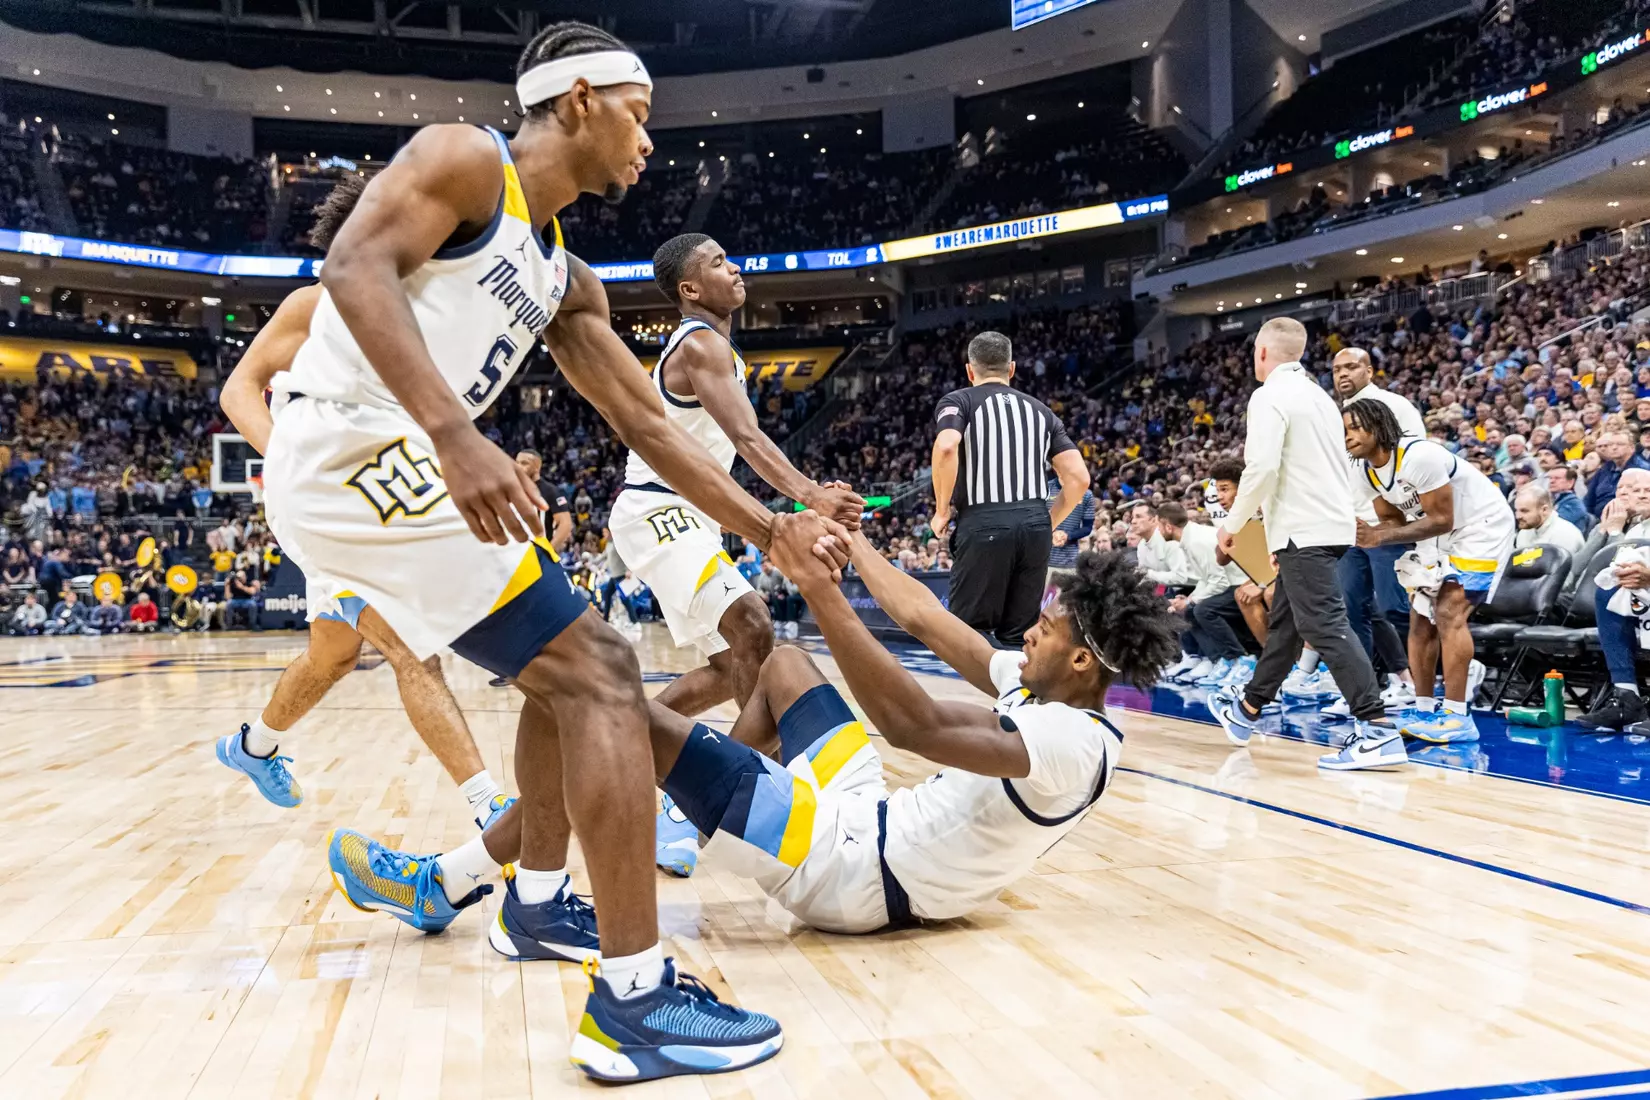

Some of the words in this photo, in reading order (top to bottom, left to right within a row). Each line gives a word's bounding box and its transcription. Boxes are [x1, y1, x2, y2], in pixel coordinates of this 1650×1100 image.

[1596, 33, 1641, 64] clover
[1477, 87, 1527, 113] clover
[1349, 129, 1392, 152] clover
[1237, 165, 1275, 186] clover
[936, 215, 1059, 250] #WEAREMARQUETTE
[81, 242, 179, 266] MARQUETTE
[744, 256, 769, 271] FLS
[827, 252, 851, 266] TOL
[36, 352, 181, 383] ARE
[463, 333, 519, 407] 5
[265, 594, 307, 614] meije
